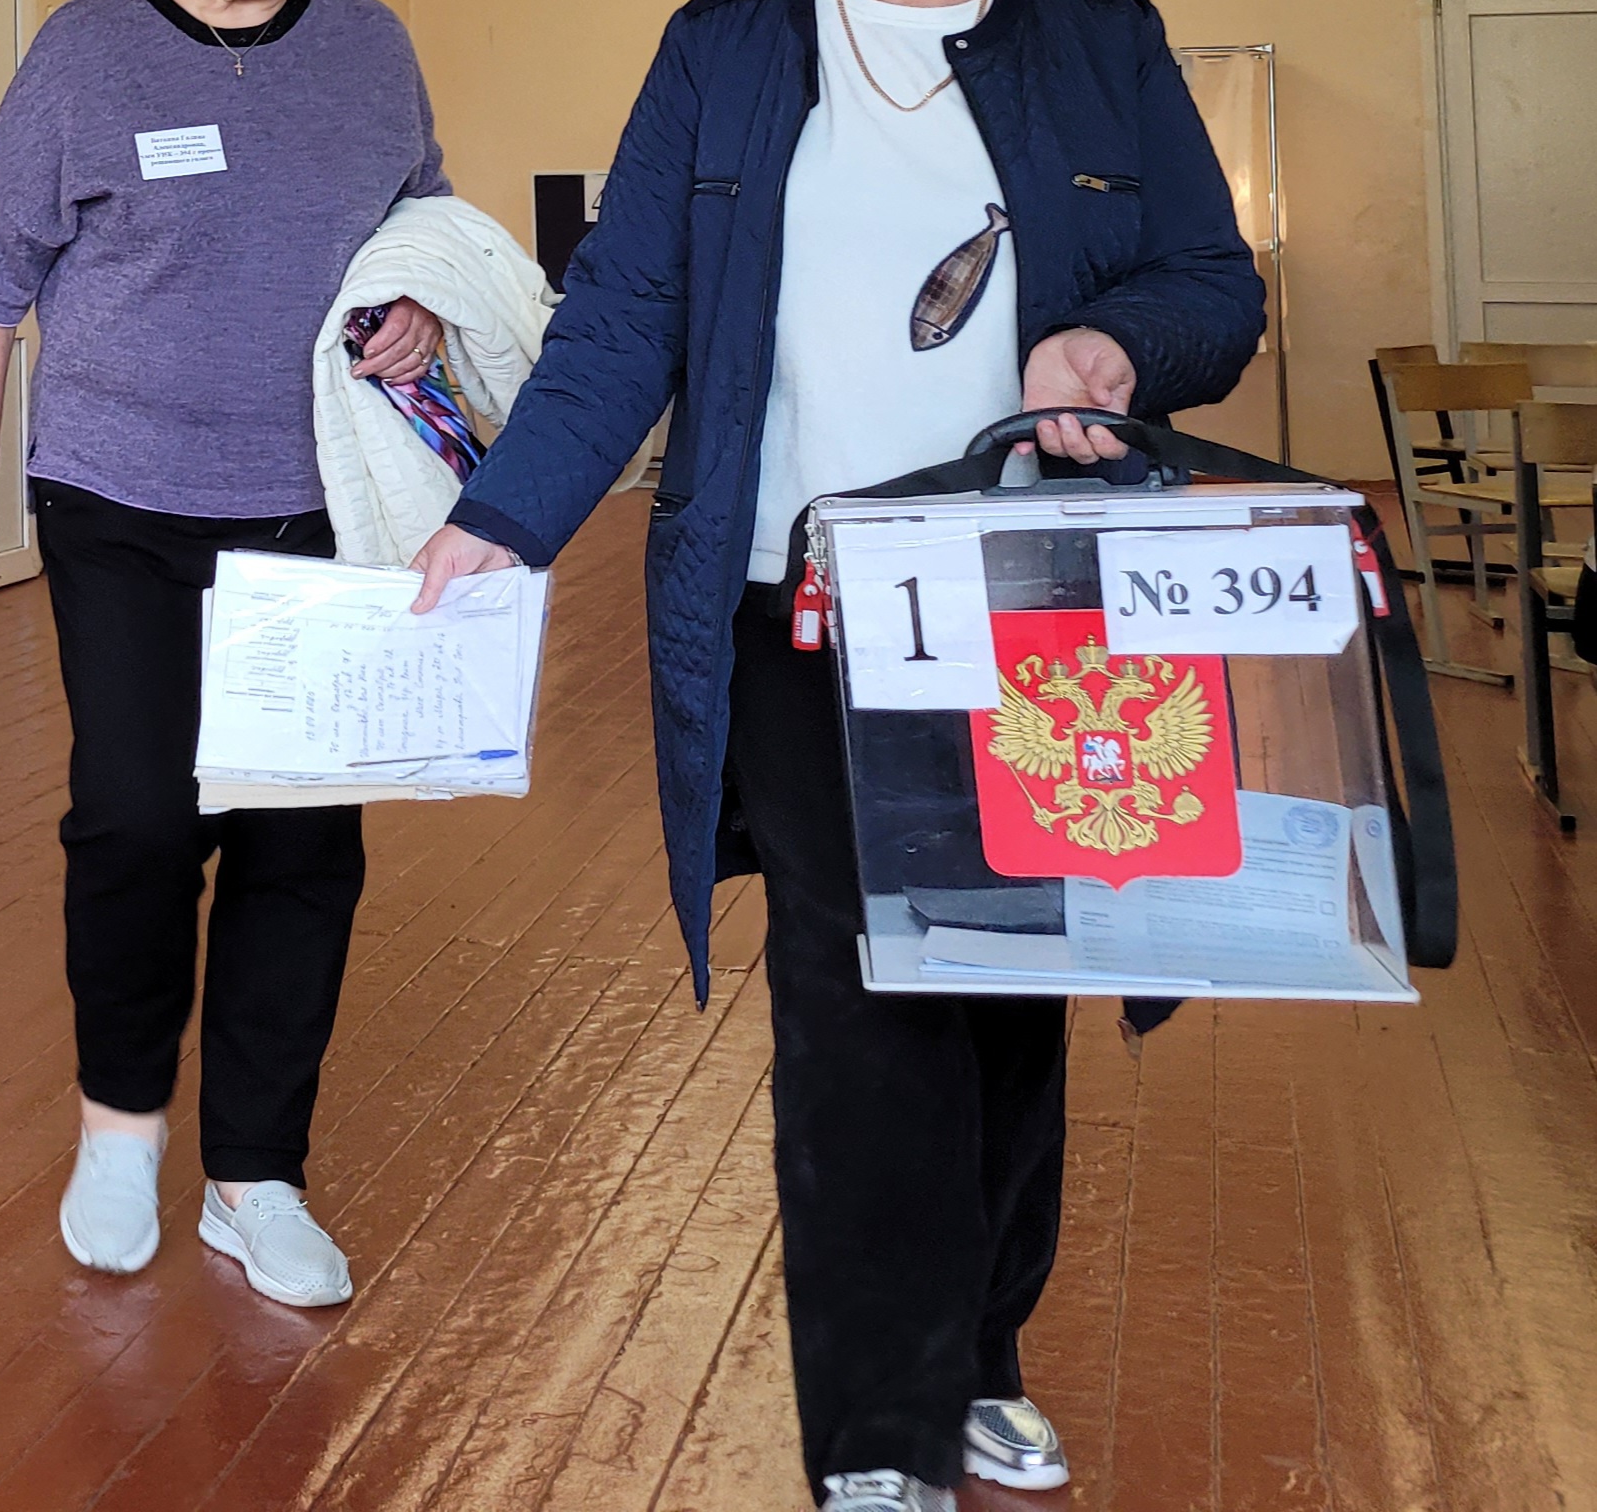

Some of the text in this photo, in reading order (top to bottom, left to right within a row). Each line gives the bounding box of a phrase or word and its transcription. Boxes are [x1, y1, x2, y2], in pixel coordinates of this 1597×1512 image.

[894, 576, 939, 662] 1
[1117, 565, 1323, 618] № 394
